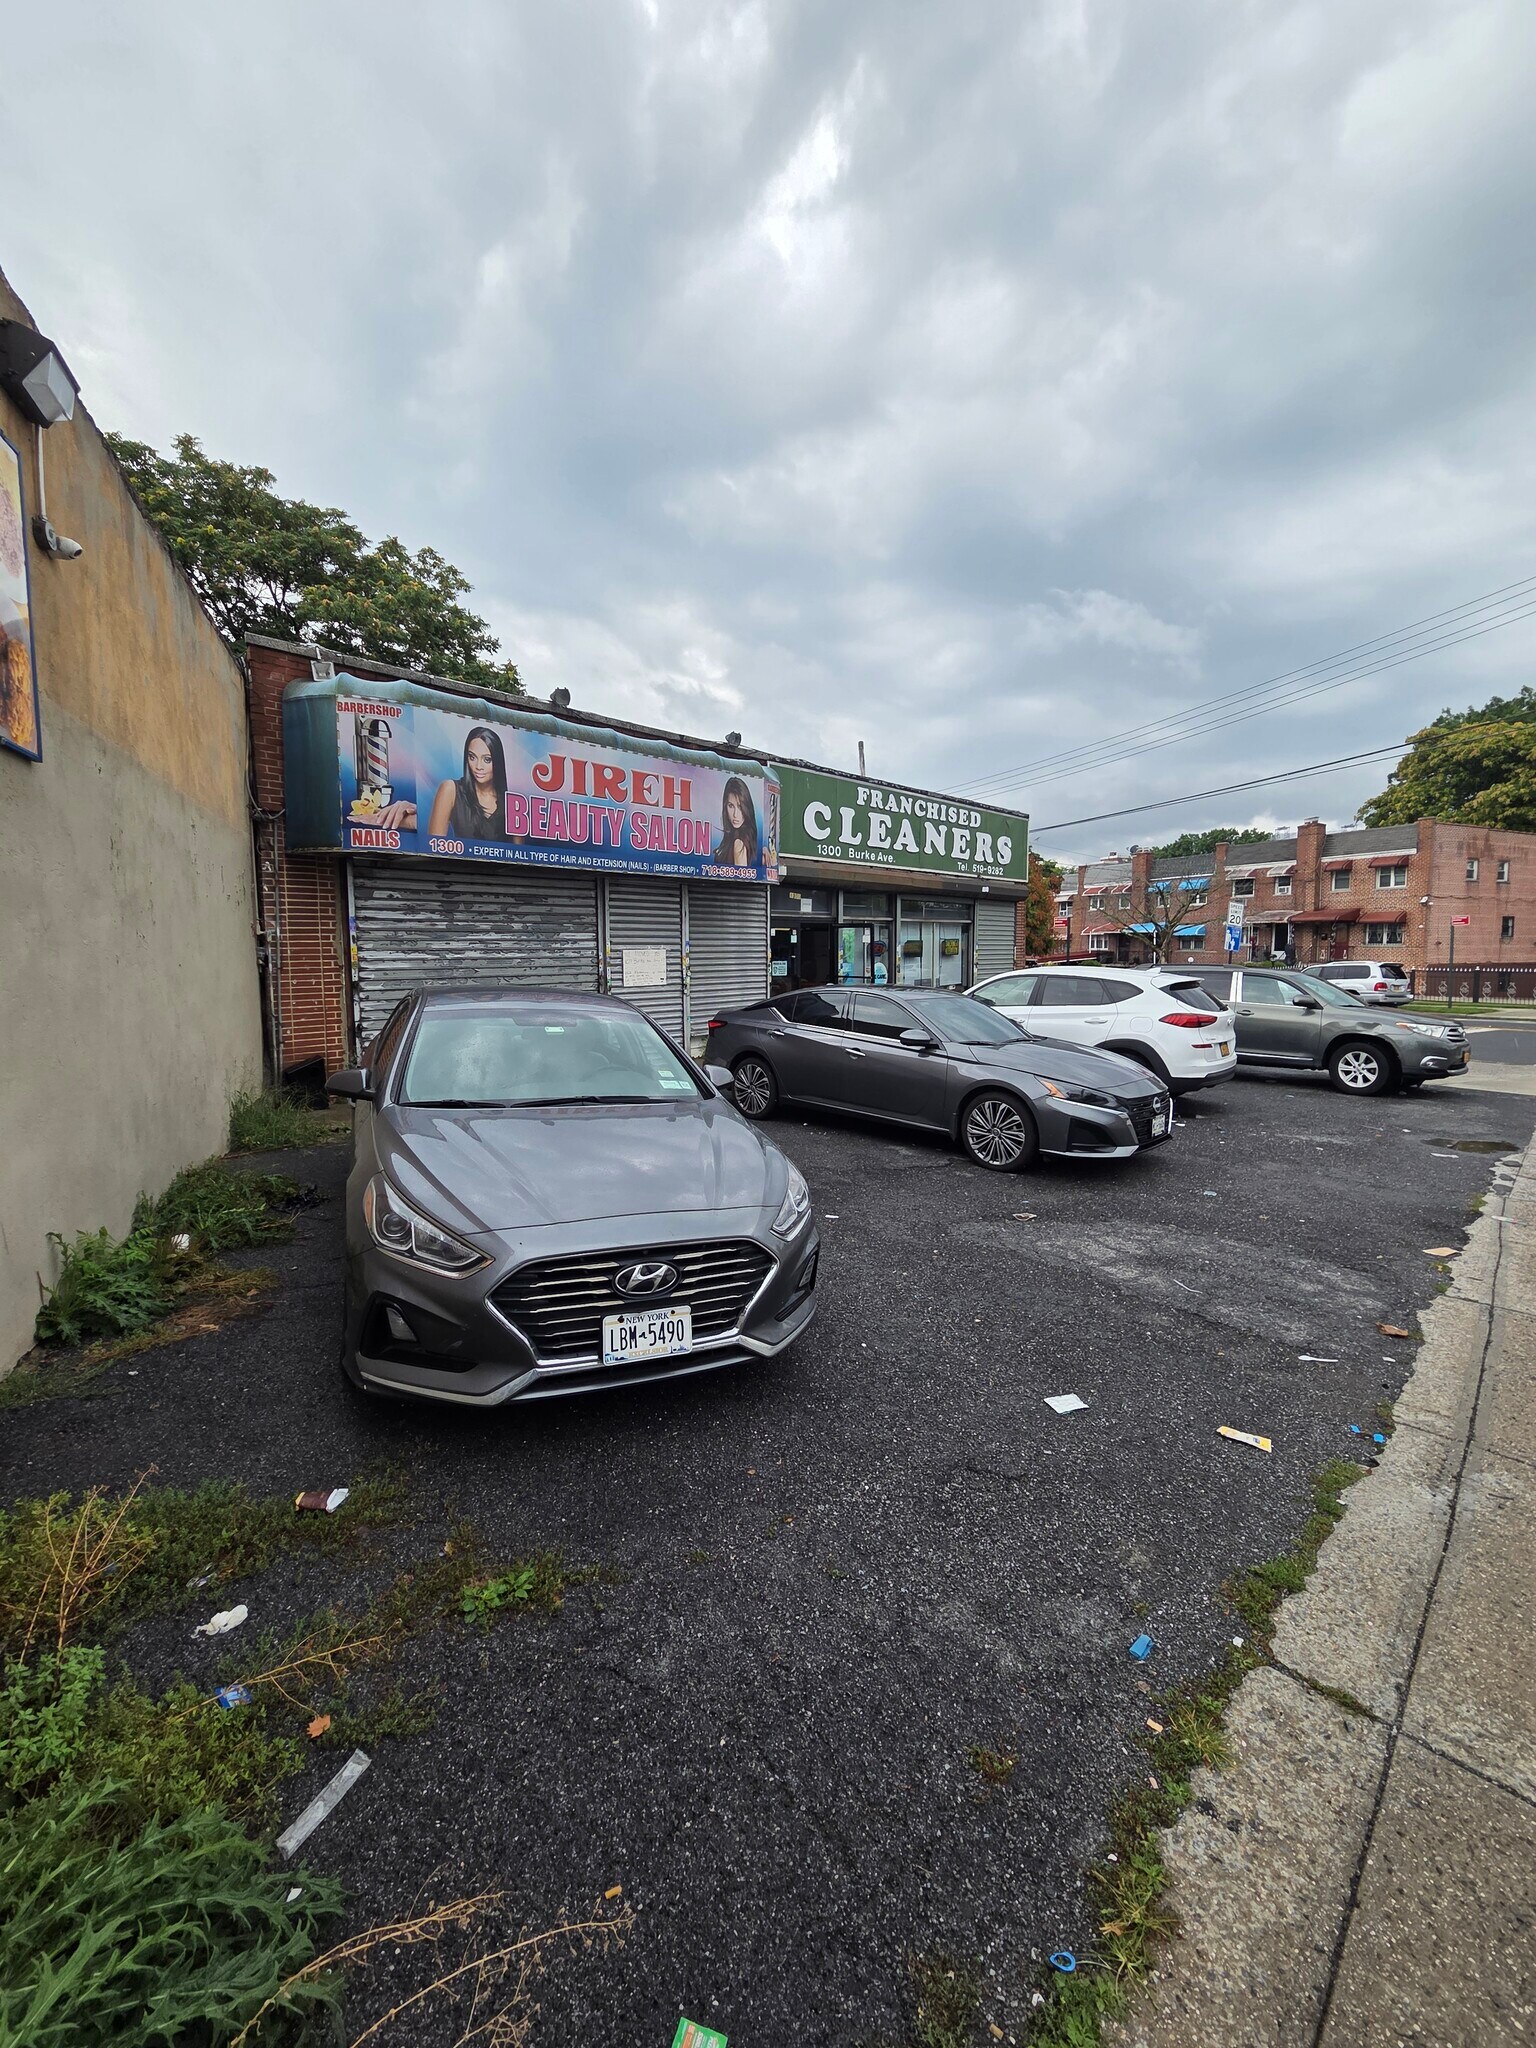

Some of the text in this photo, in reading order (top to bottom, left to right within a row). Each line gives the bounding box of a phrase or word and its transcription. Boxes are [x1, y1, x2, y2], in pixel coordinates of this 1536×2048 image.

[337, 701, 402, 718] BARBERSHOP
[531, 753, 692, 812] JIREH
[856, 786, 982, 828] FRANCHISED
[505, 791, 711, 856] BEAUTY SALON
[803, 801, 1012, 865] CLEANERS
[351, 828, 401, 849] NAILS
[429, 838, 464, 854] 1300
[473, 846, 504, 858] EXPERT
[505, 849, 514, 858] IN
[514, 850, 529, 860] ALL
[530, 851, 548, 862] TYPE
[549, 853, 559, 863] OF
[560, 854, 577, 864] HAIR
[577, 857, 592, 866] AND
[592, 857, 628, 869] EXTENSION
[817, 844, 896, 863] 1300 Burke Ave.
[957, 861, 970, 871] Tel.
[1230, 914, 1241, 925] 20
[625, 1312, 670, 1325] NEW YORK
